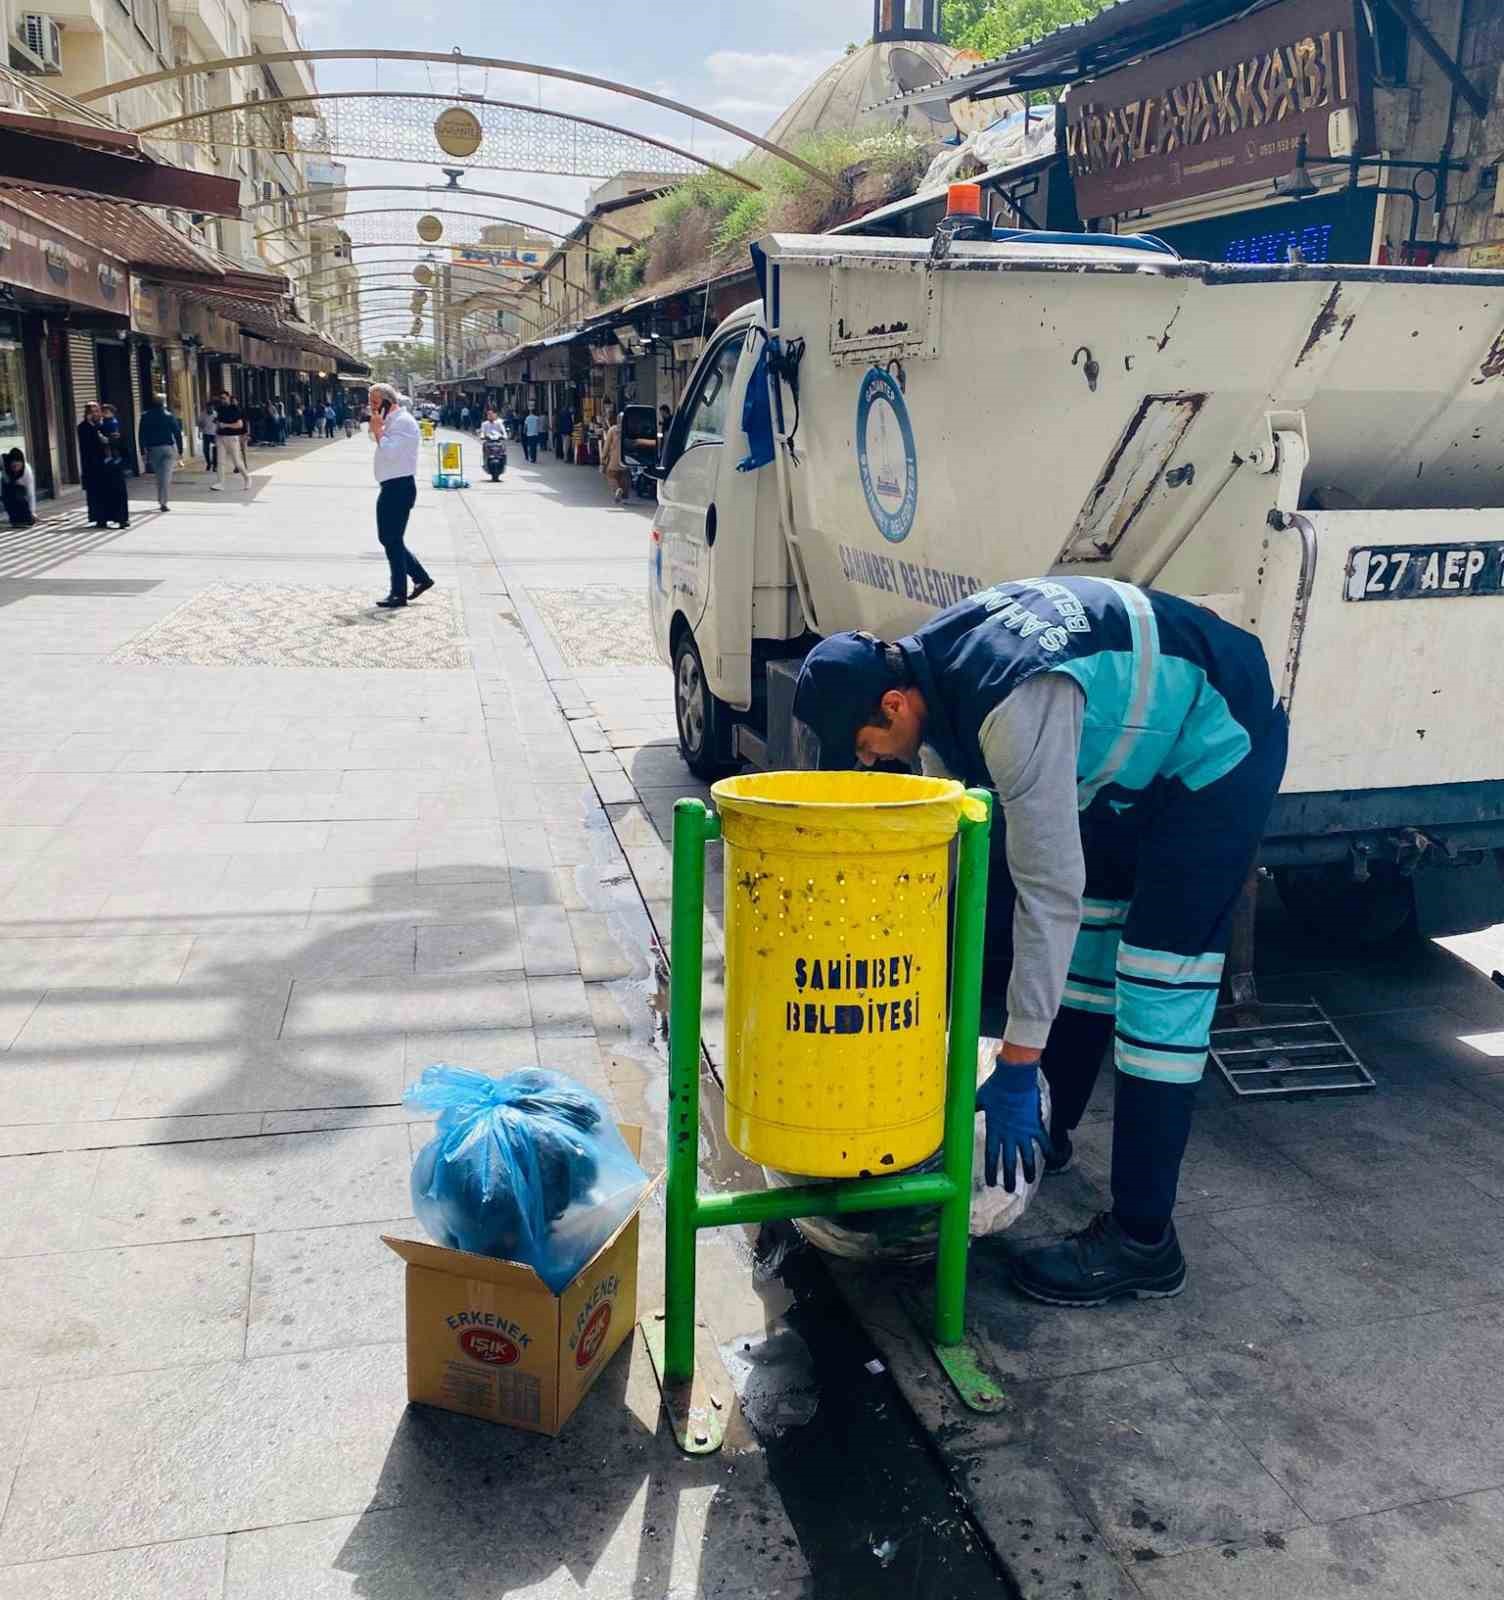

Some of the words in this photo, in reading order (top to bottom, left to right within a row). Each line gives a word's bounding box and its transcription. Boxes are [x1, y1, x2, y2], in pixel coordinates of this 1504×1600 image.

[1366, 552, 1411, 592] 27
[1421, 551, 1485, 590] AEP
[794, 952, 913, 994] ŞAHİNBEY
[786, 991, 919, 1034] BELEDİYESİ
[447, 1311, 532, 1349] ERKENEK
